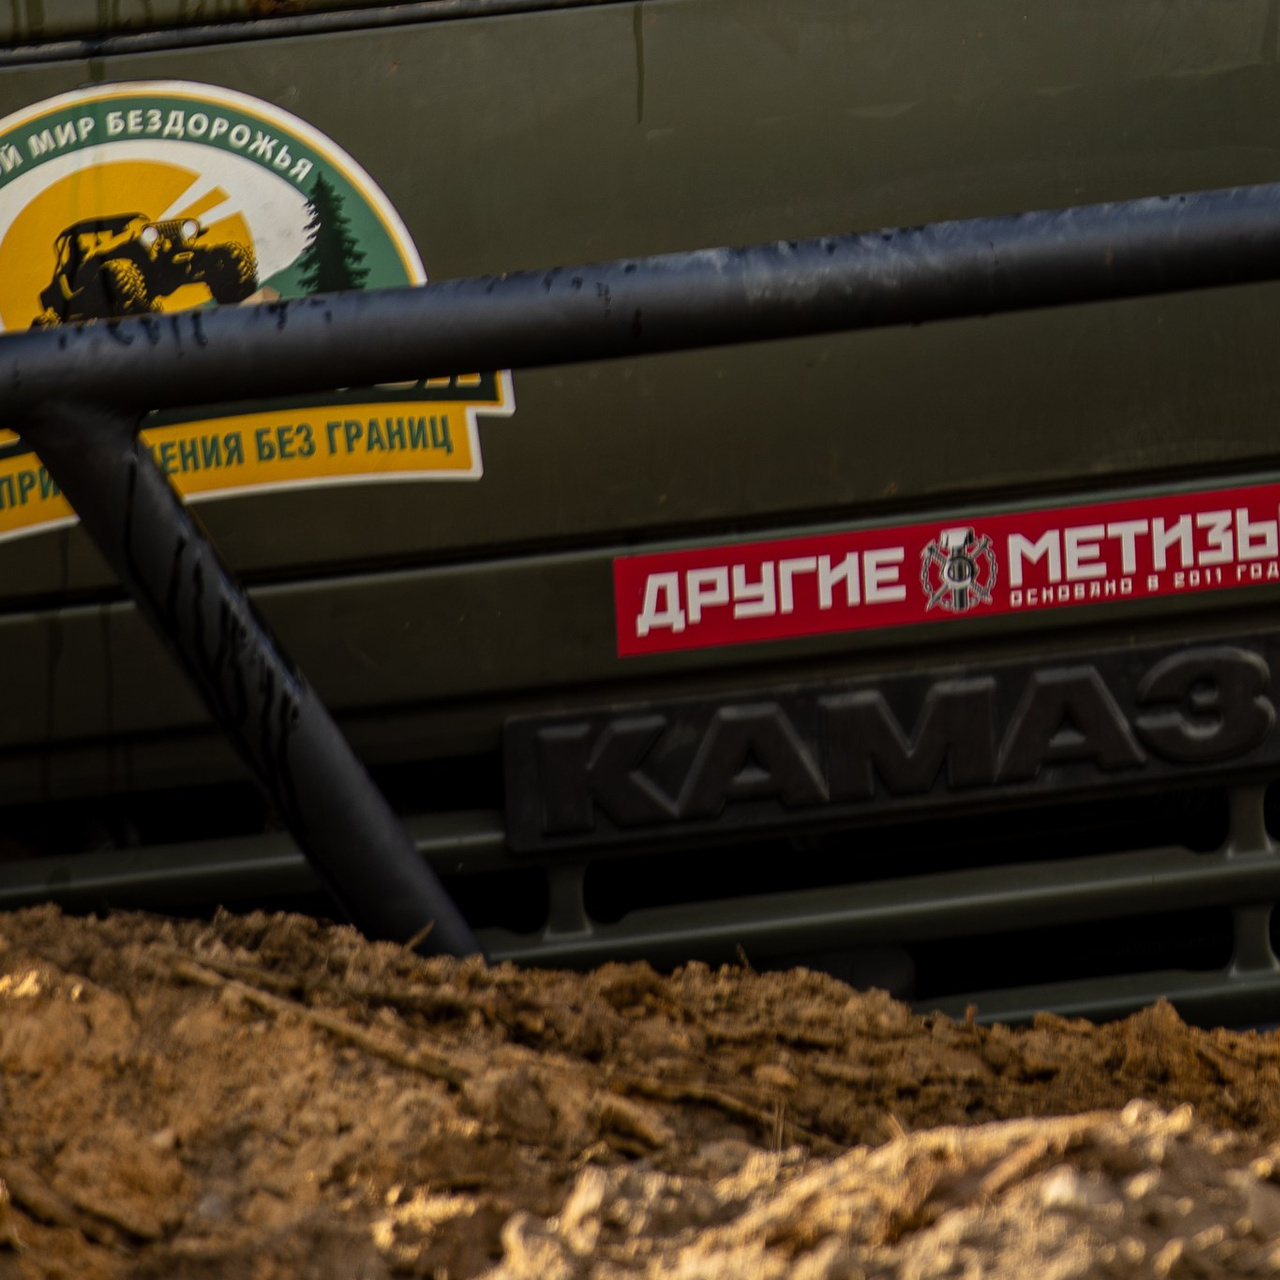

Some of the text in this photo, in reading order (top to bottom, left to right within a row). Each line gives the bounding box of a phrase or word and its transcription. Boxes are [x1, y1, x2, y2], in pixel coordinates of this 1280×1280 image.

[0, 108, 315, 184] Й МИР БЕЗДОРОЖЬЯ
[256, 423, 316, 462] БЕЗ
[326, 414, 454, 456] ГРАНИЦ
[636, 546, 908, 638] ДРУГИЕ
[1009, 577, 1134, 608] ОСНОВАНО
[1146, 574, 1160, 592] В
[1173, 567, 1223, 590] 2011
[537, 645, 1278, 838] КАМАЗ
